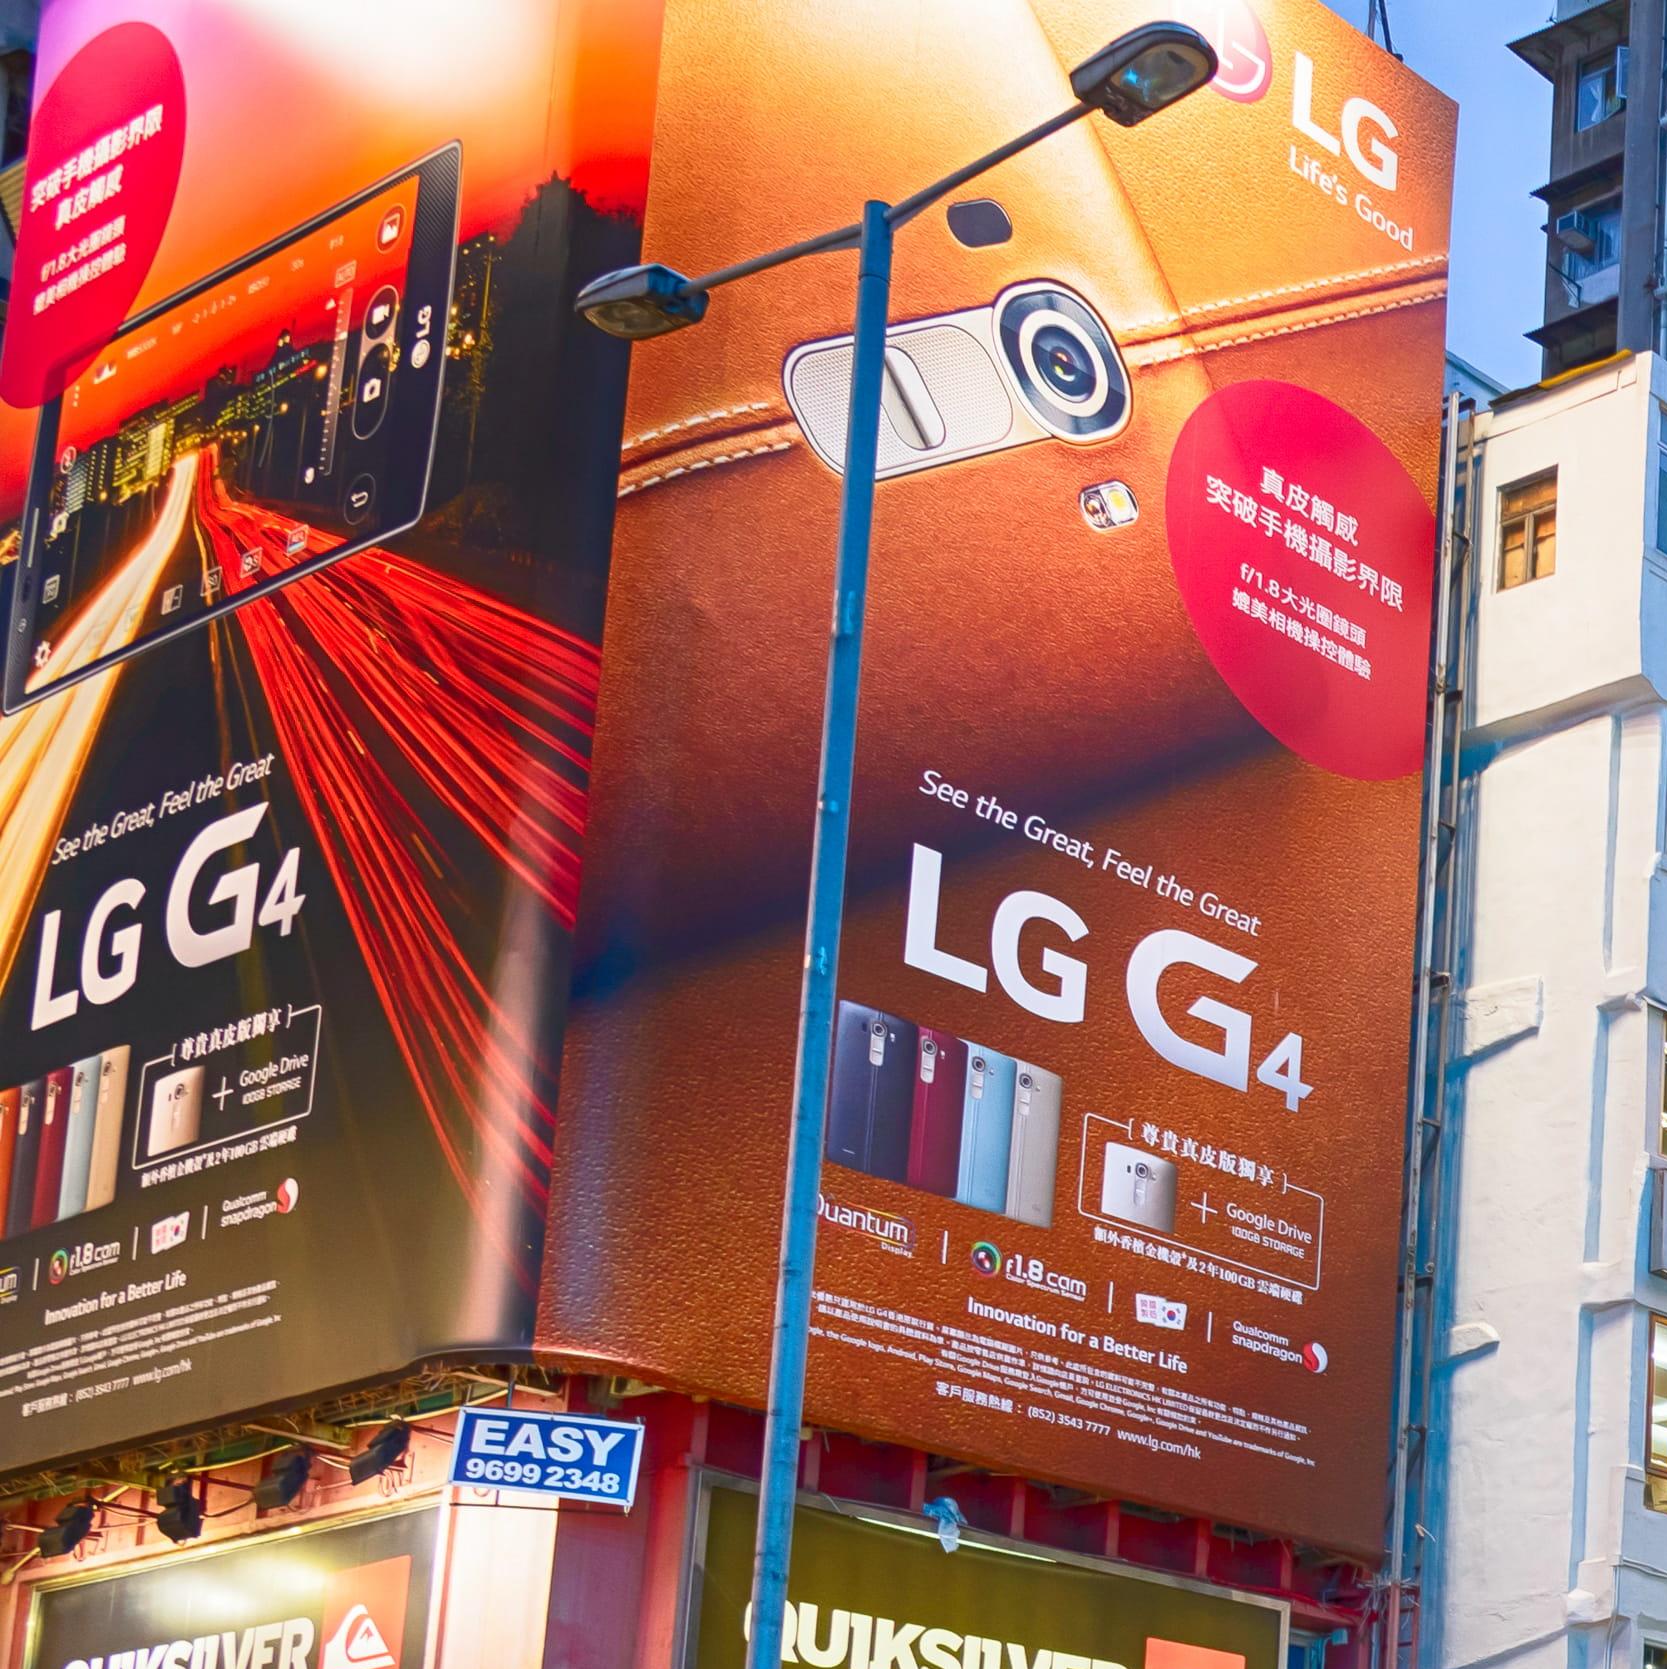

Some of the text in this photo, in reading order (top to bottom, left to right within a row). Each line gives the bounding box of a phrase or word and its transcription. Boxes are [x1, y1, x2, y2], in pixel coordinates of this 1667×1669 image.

[1292, 50, 1400, 192] LG
[1289, 146, 1414, 252] Life's Good
[416, 305, 432, 338] LG
[1261, 465, 1358, 547] 真皮觸感
[1206, 473, 1404, 613] 突破手機攝影界限
[52, 753, 275, 865] See the Great, Feel the Great
[919, 770, 1261, 937] See the Great, Feel the Great
[31, 801, 306, 1031] LG G4
[903, 842, 1314, 1113] LG G4
[239, 1053, 309, 1088] Google Drive
[1140, 1122, 1275, 1187] 尊貴真皮版獨享
[220, 1201, 277, 1228] snapdragon
[222, 1191, 267, 1213] Qualcomm
[1226, 1203, 1313, 1245] Google Drive
[1231, 1225, 1304, 1259] 100GB STORAGE
[44, 1269, 188, 1326] Innovation for a Better Life
[1046, 1271, 1087, 1296] cam
[968, 1296, 1188, 1374] Innovation for a Better Life
[1232, 1321, 1288, 1346] Qualcomm
[1232, 1334, 1303, 1365] snapdragon
[470, 1419, 625, 1466] EASY
[1028, 1405, 1056, 1424] (852)
[1057, 1408, 1084, 1430] 3543
[1086, 1420, 1111, 1436] 7777
[1117, 1429, 1201, 1460] www.lg.com/hk
[465, 1458, 620, 1494] 9699 2348
